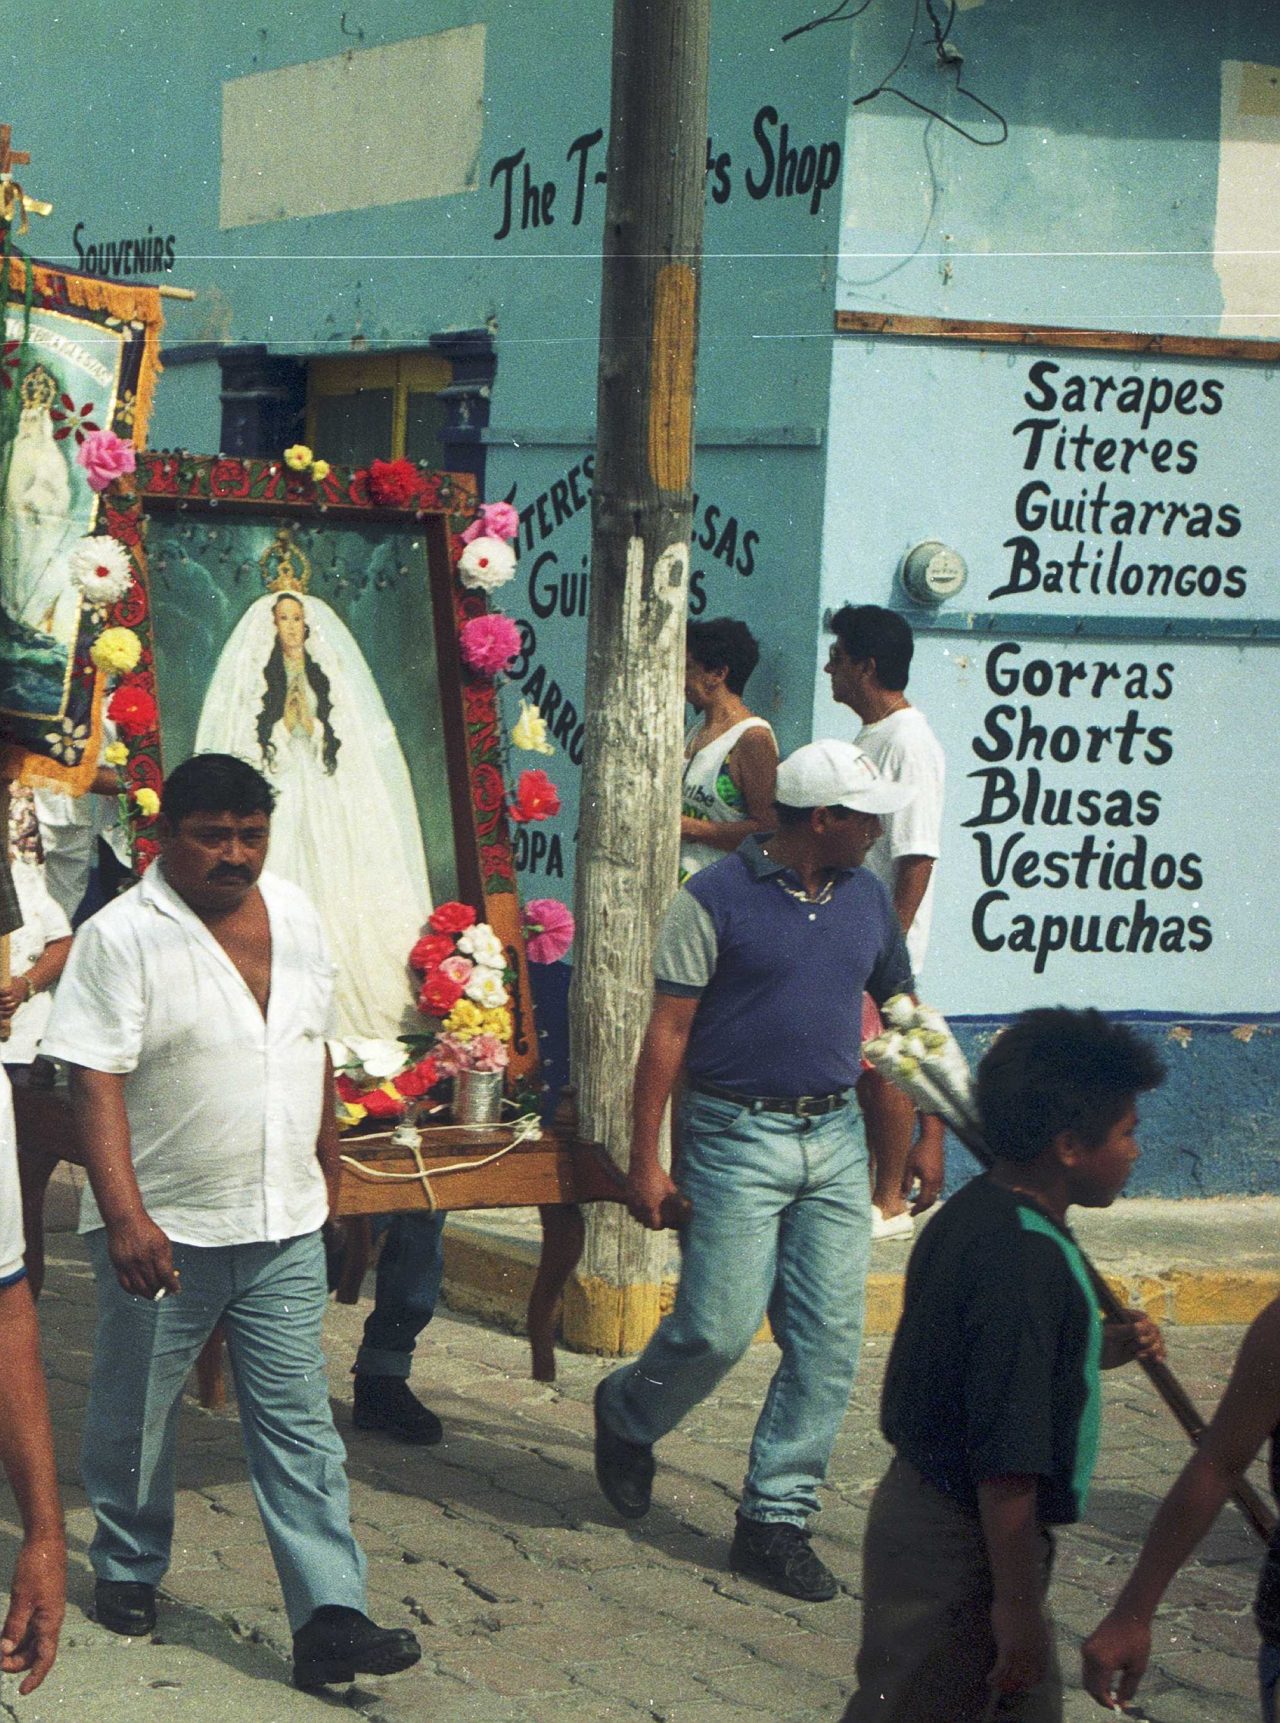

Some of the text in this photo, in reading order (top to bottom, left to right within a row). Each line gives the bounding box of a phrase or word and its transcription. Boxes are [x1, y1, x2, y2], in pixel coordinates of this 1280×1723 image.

[490, 147, 556, 240] The
[745, 105, 841, 215] Shop
[1024, 361, 1224, 430] Sarapes
[1013, 418, 1198, 474] Titeres
[1015, 480, 1242, 538] Guitarras
[985, 642, 1174, 700] Gorras
[972, 704, 1173, 766] Shorts
[960, 766, 1162, 828] Blusas
[972, 831, 1203, 891] Vestidos
[972, 890, 1213, 974] Capuchas
